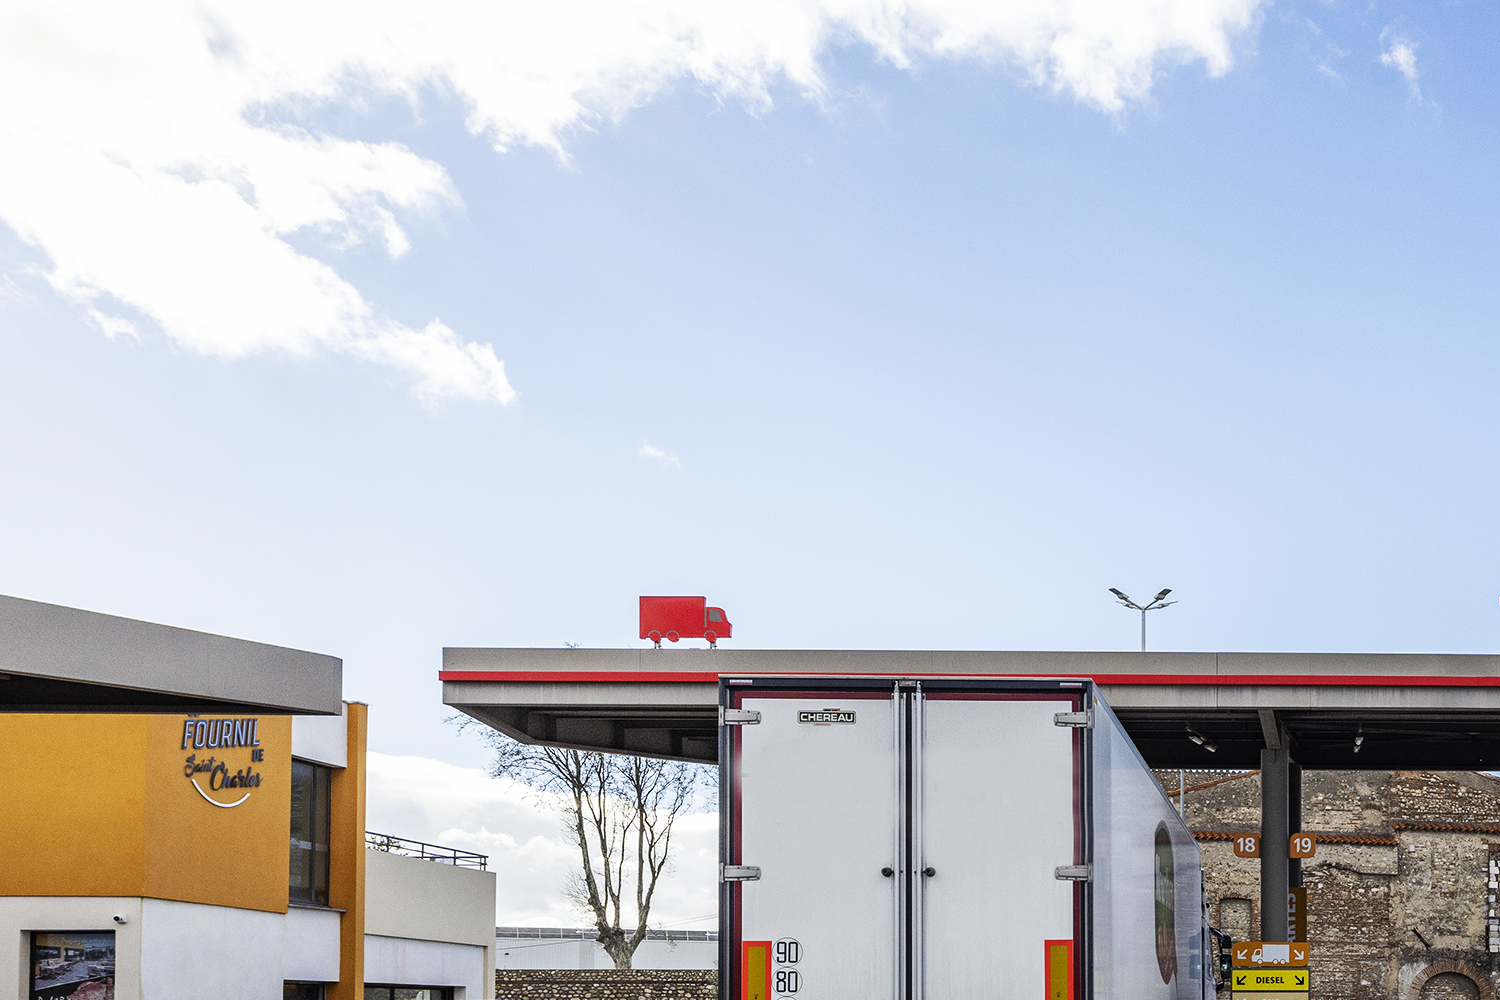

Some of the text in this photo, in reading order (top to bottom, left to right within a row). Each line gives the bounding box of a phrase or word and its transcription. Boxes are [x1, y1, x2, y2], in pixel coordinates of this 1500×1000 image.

[800, 713, 854, 722] CHEREAU
[181, 718, 260, 750] FOURNIL
[251, 748, 264, 762] DE
[184, 753, 264, 791] Saint Charles
[1236, 837, 1256, 853] 18
[1293, 837, 1312, 853] 19
[776, 941, 798, 963] 90
[776, 971, 798, 993] 80
[1256, 976, 1285, 984] DIESEL
